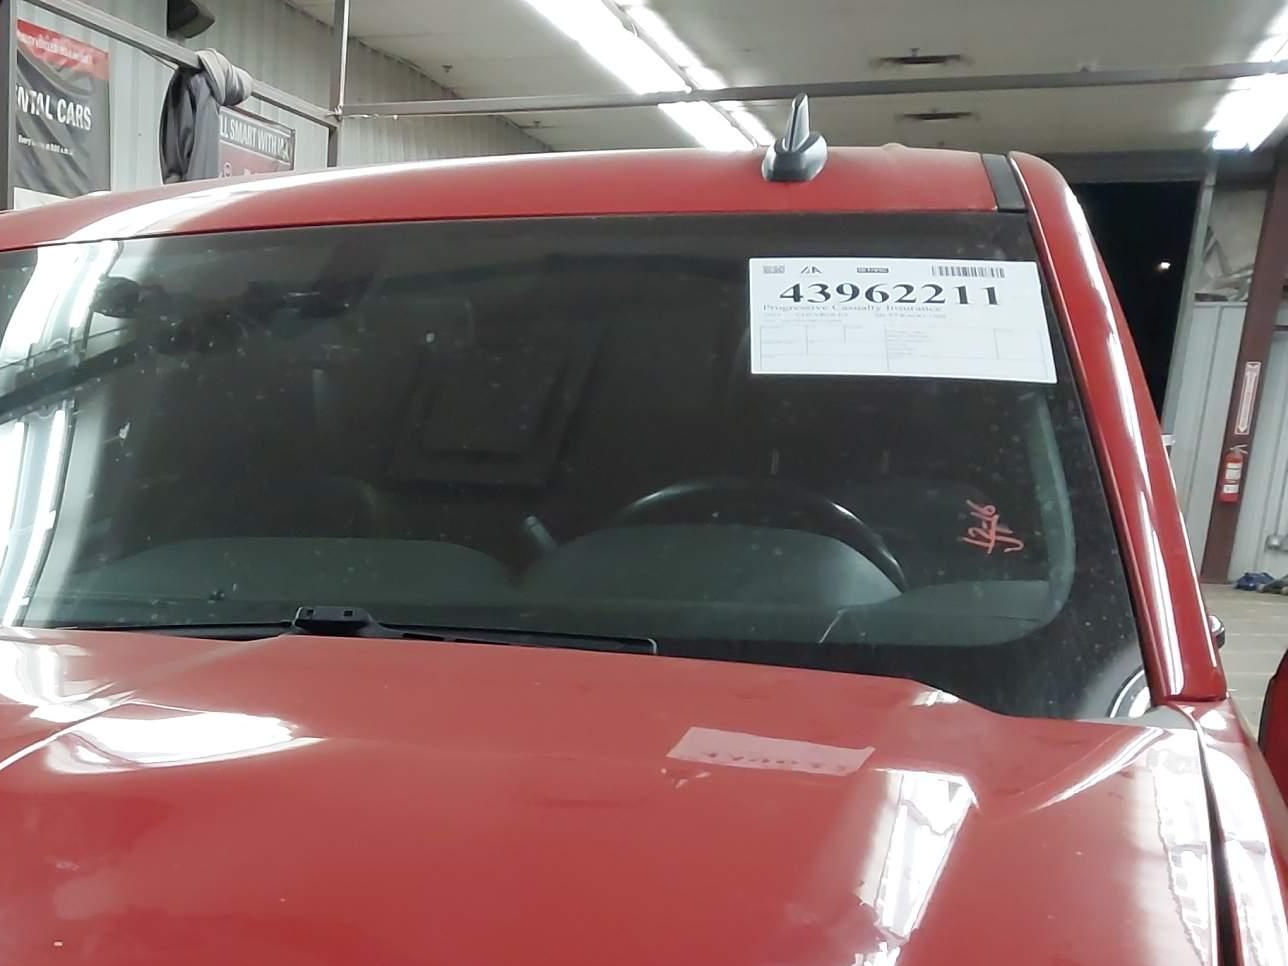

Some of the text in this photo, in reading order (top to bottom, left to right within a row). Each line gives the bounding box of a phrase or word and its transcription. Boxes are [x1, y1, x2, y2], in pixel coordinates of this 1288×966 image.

[16, 85, 92, 131] NTAL CARS
[231, 119, 257, 147] SMART
[779, 283, 1001, 305] 43962211
